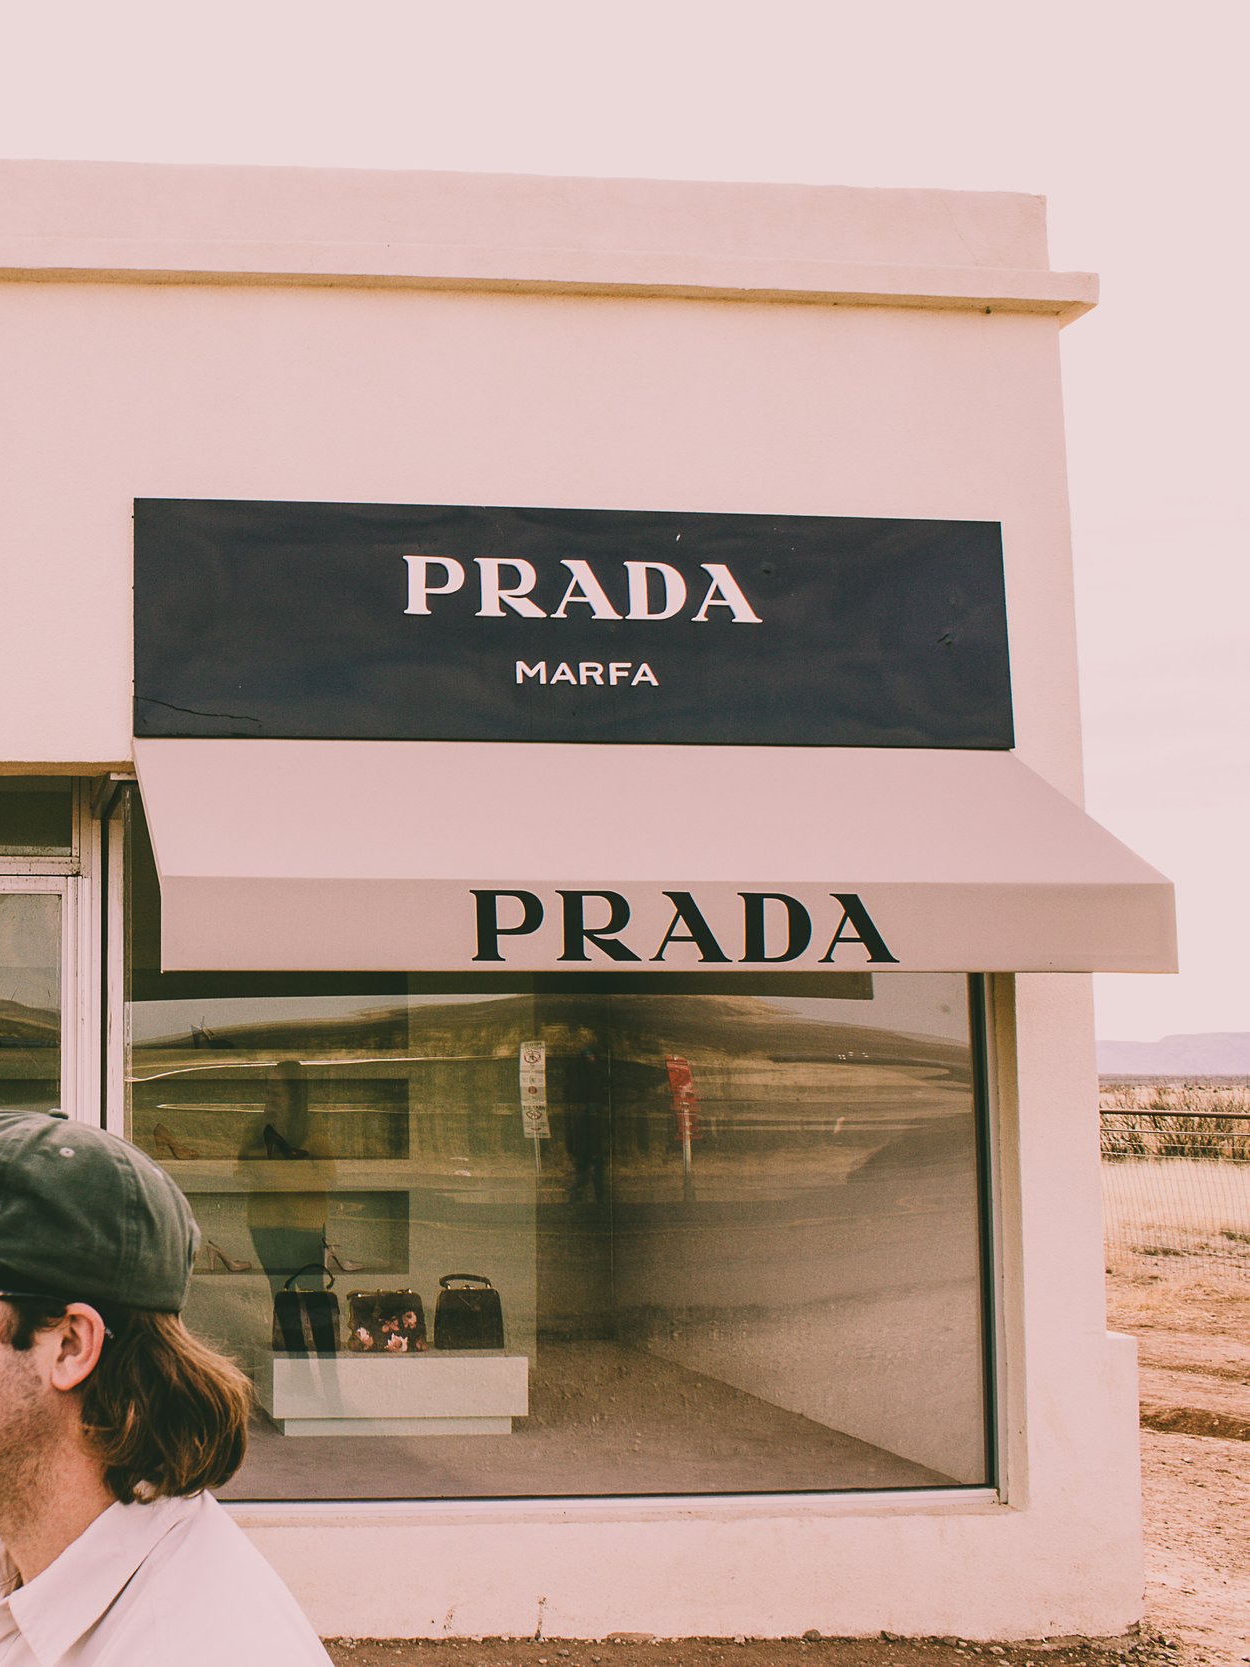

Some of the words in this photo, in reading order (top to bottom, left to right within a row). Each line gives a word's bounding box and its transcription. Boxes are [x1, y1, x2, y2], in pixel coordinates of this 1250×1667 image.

[403, 555, 763, 624] PRADA
[515, 660, 659, 687] MARFA
[469, 890, 900, 963] PRADA
